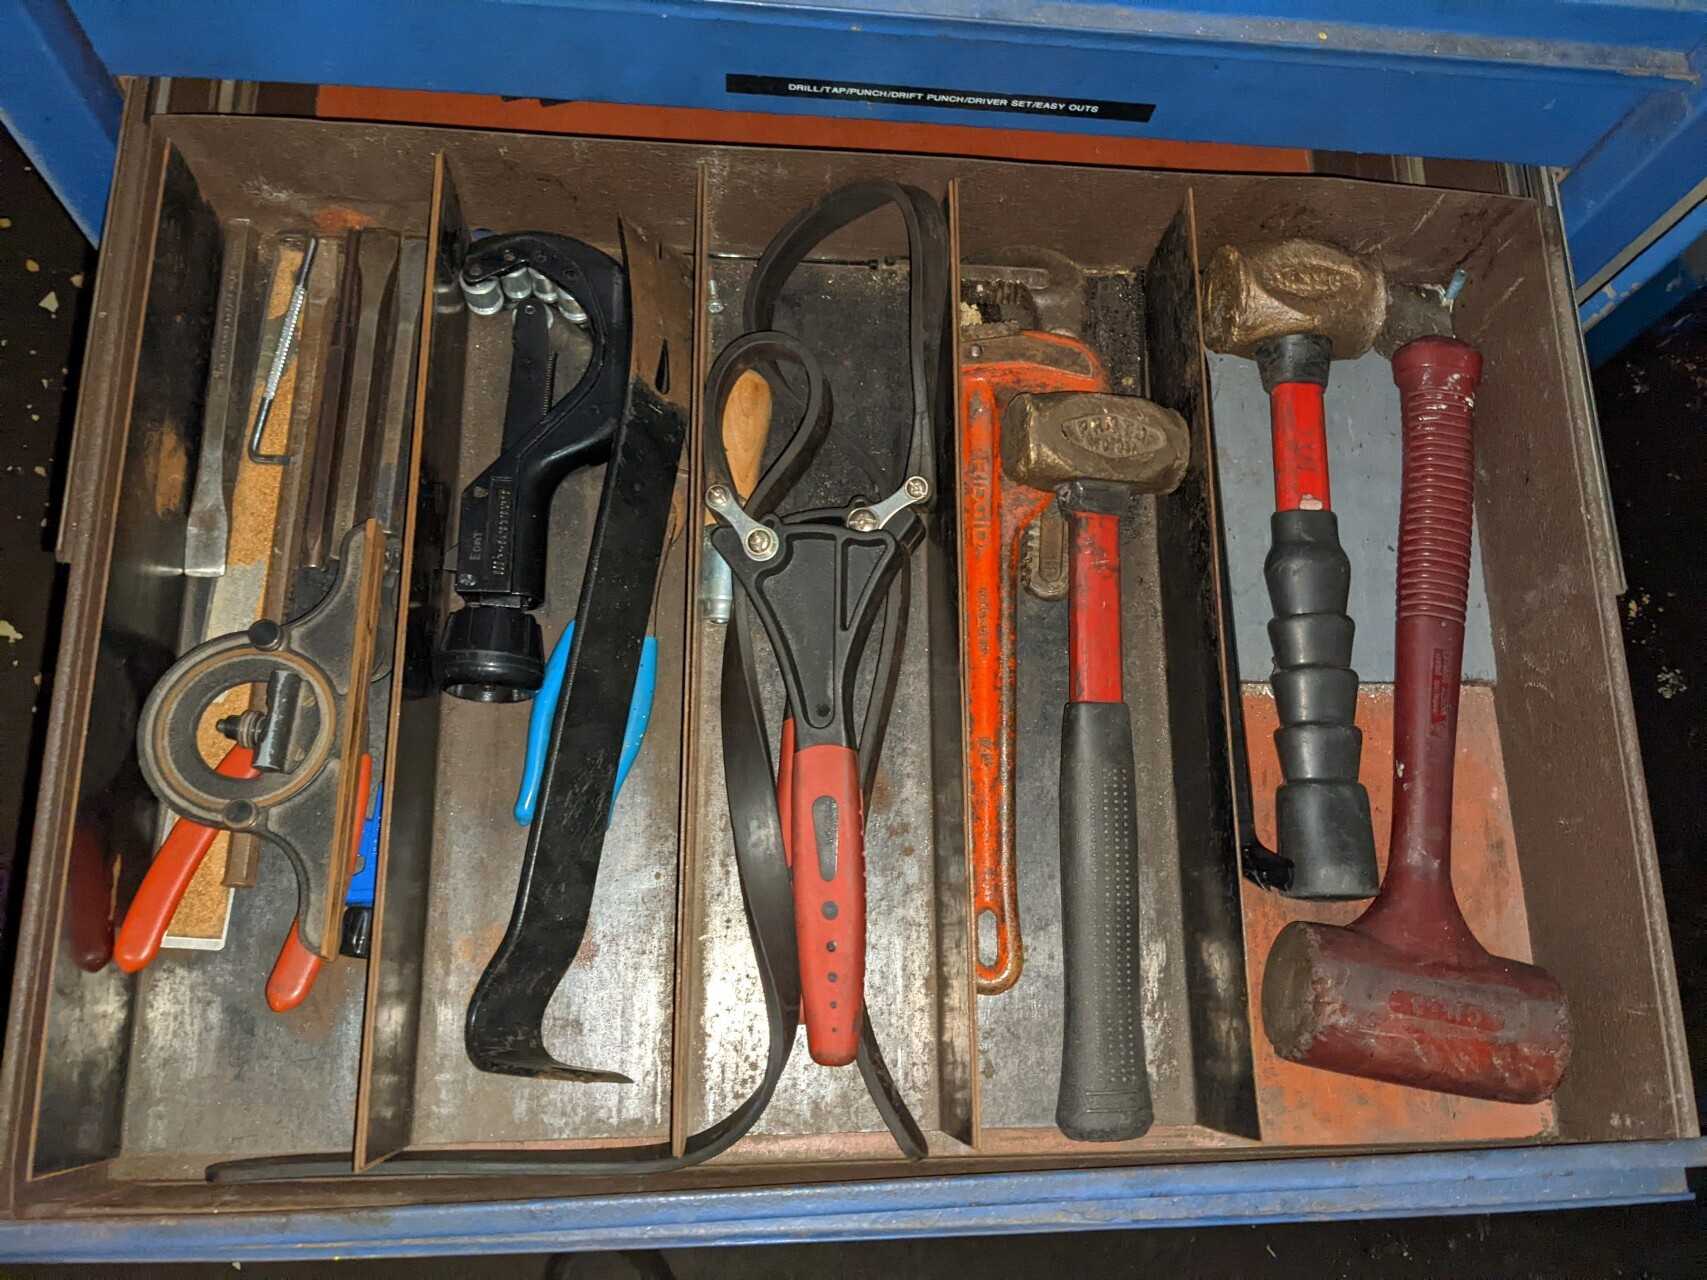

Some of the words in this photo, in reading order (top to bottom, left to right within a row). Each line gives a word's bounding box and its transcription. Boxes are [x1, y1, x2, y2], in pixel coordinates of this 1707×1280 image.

[788, 83, 924, 100] DRILL/TAP/PUNCH/DRIFT
[926, 94, 1008, 107] PUNCH/DRIVER
[1011, 99, 1066, 111] SET/EASY
[1069, 104, 1100, 113] OUTS
